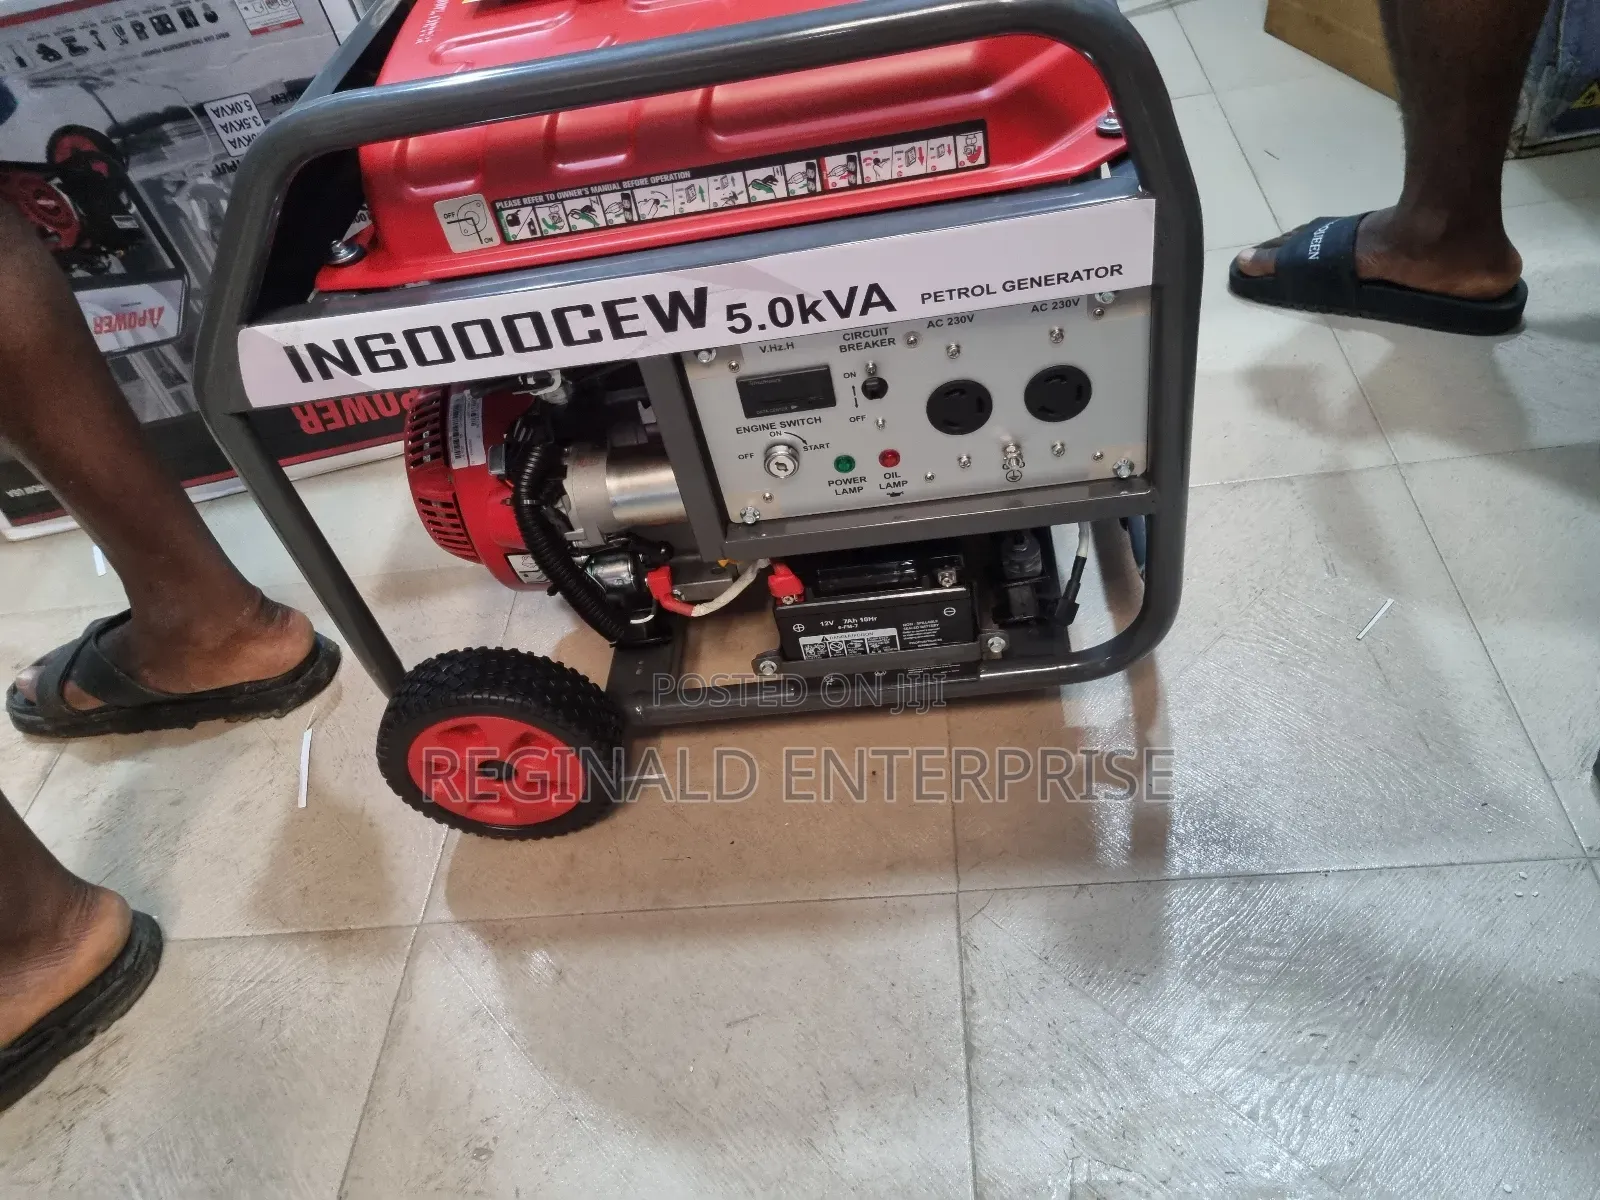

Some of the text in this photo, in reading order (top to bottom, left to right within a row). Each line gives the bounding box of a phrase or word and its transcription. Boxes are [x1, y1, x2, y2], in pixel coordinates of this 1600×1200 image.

[210, 99, 253, 118] 5.0KVA
[219, 115, 261, 134] 3.5KVA
[495, 171, 691, 210] PLEASE REFER TO OWNER'S MANUAL BEFORE OPERATION
[443, 211, 455, 219] OFF
[1031, 297, 1081, 313] AC 230V
[282, 263, 1124, 384] IN6000CEW 5.0kVA PETROL GENERATOR
[926, 313, 976, 329] AC 230V
[842, 327, 890, 342] CIRCUIT
[759, 342, 795, 354] V.Hz.H
[839, 337, 897, 353] BREAKER
[843, 371, 857, 379] ON
[849, 415, 867, 423] OFF
[736, 416, 822, 435] ENGINE SWITCH
[802, 443, 830, 452] START
[827, 476, 867, 487] POWER
[883, 471, 902, 480] OIL
[834, 486, 864, 496] LAMP
[879, 480, 908, 490] LAMP
[843, 617, 858, 625] 7Ah
